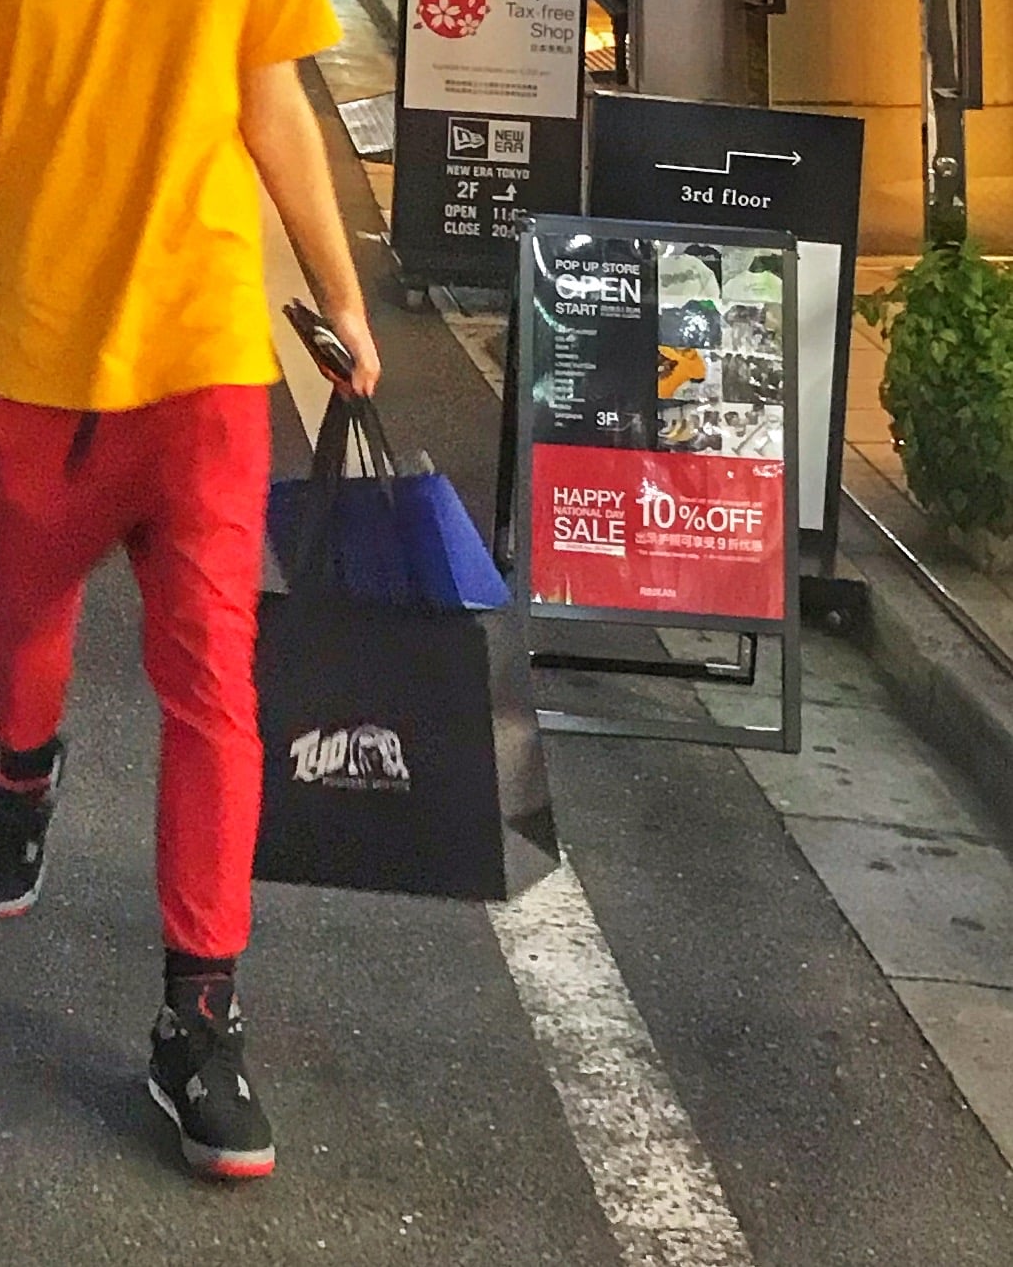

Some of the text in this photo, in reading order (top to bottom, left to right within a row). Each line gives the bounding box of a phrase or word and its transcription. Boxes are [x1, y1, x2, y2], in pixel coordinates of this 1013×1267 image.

[530, 23, 574, 43] Shop
[495, 129, 524, 142] NEW
[495, 141, 524, 153] ERA
[446, 164, 530, 179] NEW ERA TOKYO
[457, 181, 479, 199] 2F
[681, 185, 771, 209] 3rd floor
[444, 204, 477, 219] OPEN
[444, 221, 480, 236] CLOSE
[555, 259, 640, 275] POP UP STORE
[555, 273, 641, 304] OPEN
[555, 302, 598, 316] START
[553, 486, 626, 509] HAPPY
[553, 505, 603, 518] NATIONAL
[553, 516, 626, 544] SALE
